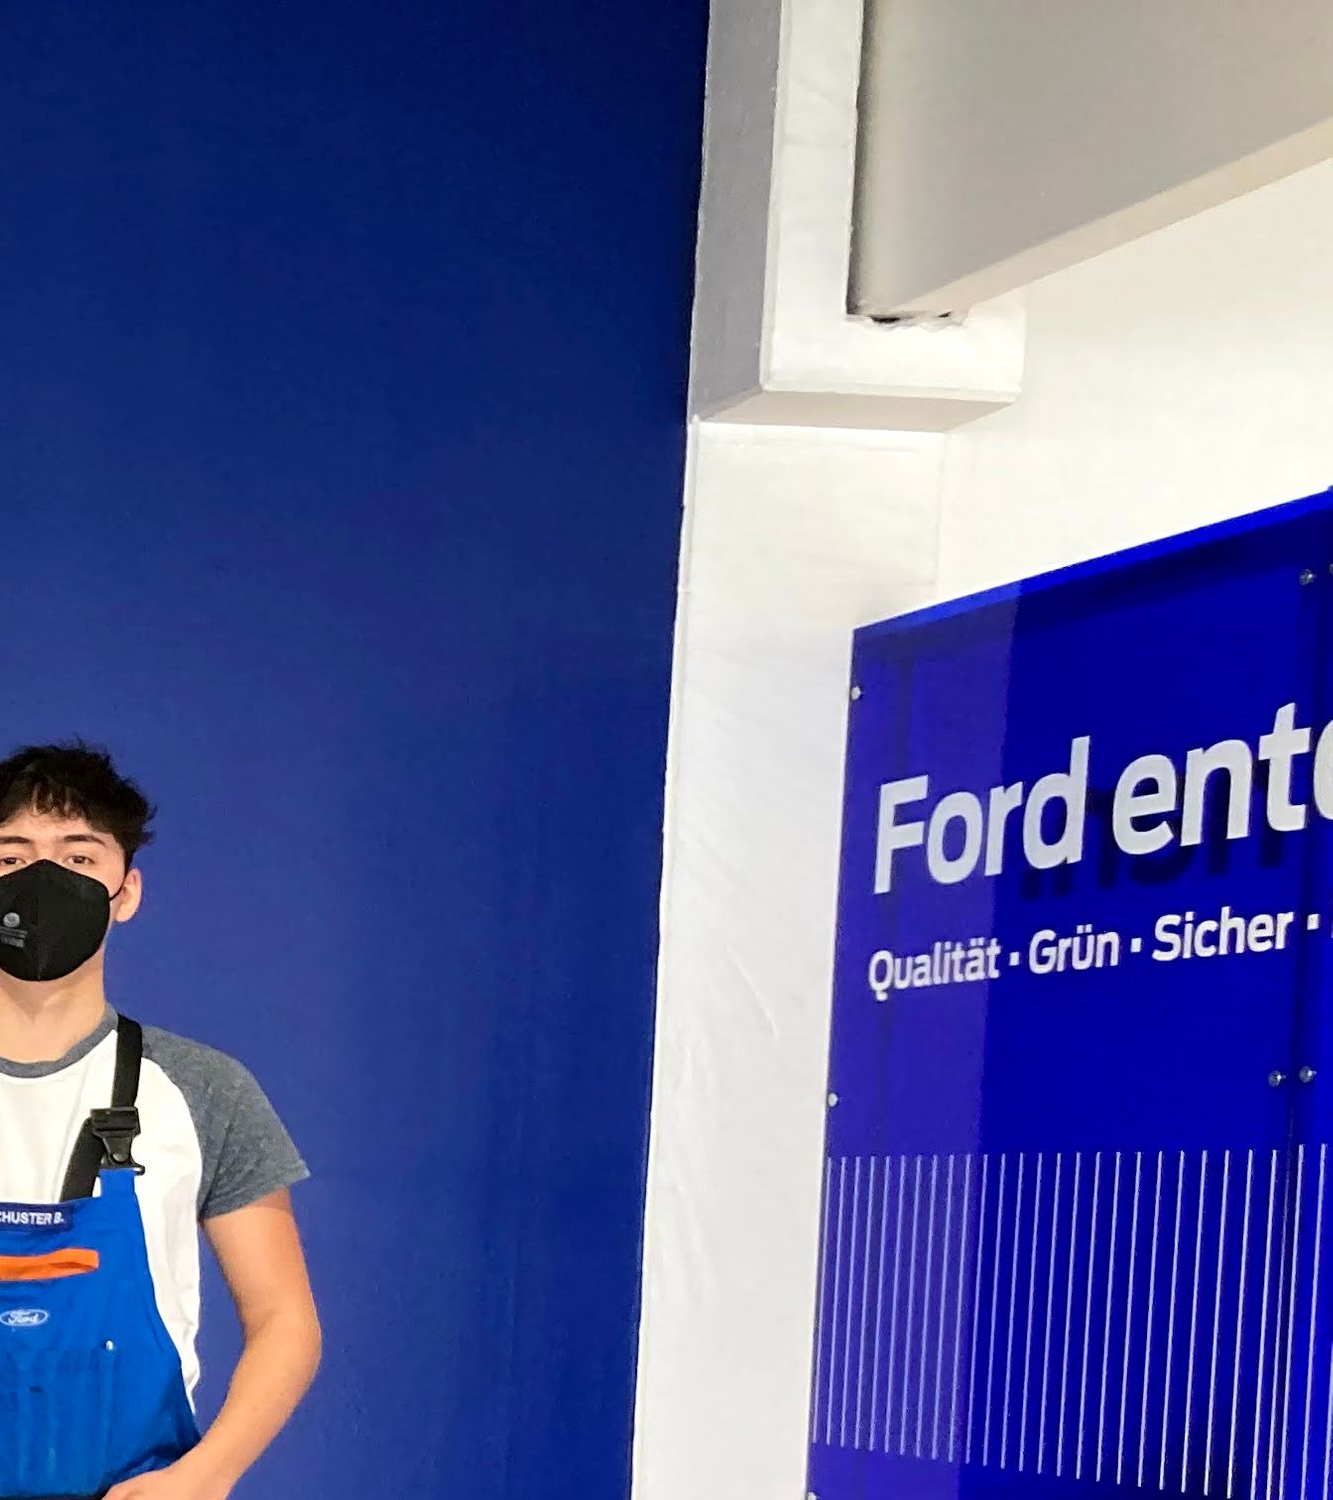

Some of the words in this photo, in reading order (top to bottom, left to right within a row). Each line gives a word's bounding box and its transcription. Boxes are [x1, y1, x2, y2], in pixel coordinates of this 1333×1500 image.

[873, 736, 1091, 895] Ford
[1112, 702, 1333, 856] ent
[868, 937, 1002, 1002] Qualität
[1029, 925, 1120, 975] Grün
[1152, 905, 1295, 963] Sicher
